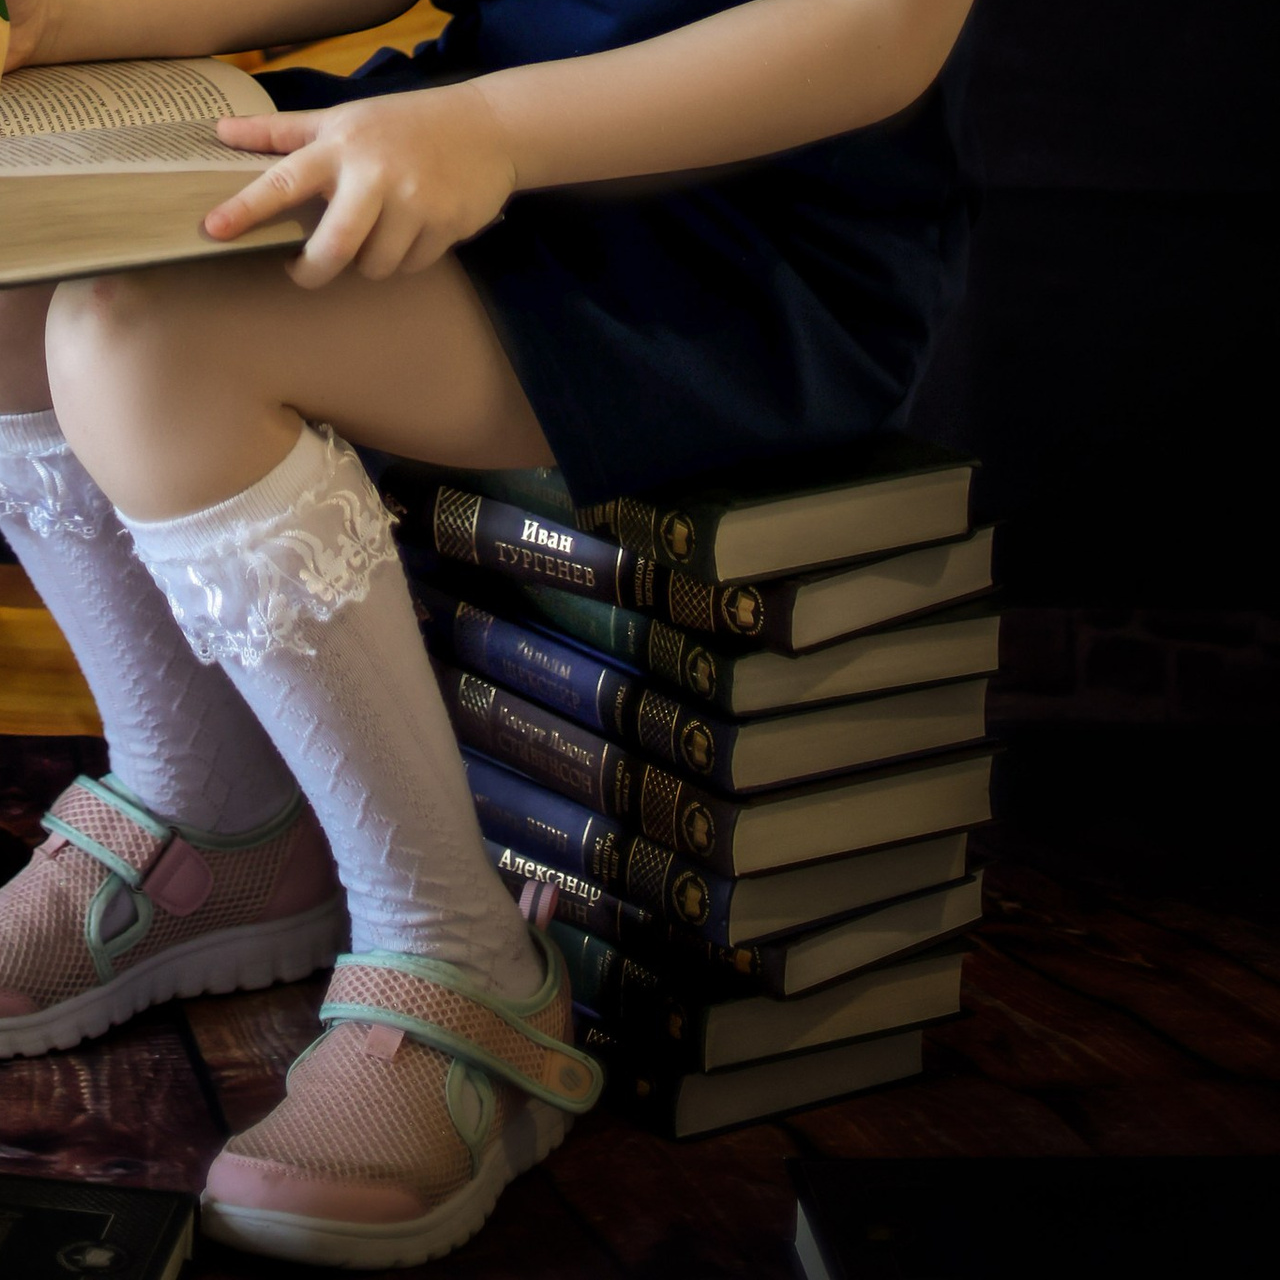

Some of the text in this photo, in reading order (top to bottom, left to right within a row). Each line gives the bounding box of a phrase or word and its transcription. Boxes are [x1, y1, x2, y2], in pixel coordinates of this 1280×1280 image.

[519, 518, 574, 554] Иван
[494, 541, 596, 588] ТУРГЕНЕВ
[497, 847, 603, 906] Александр
